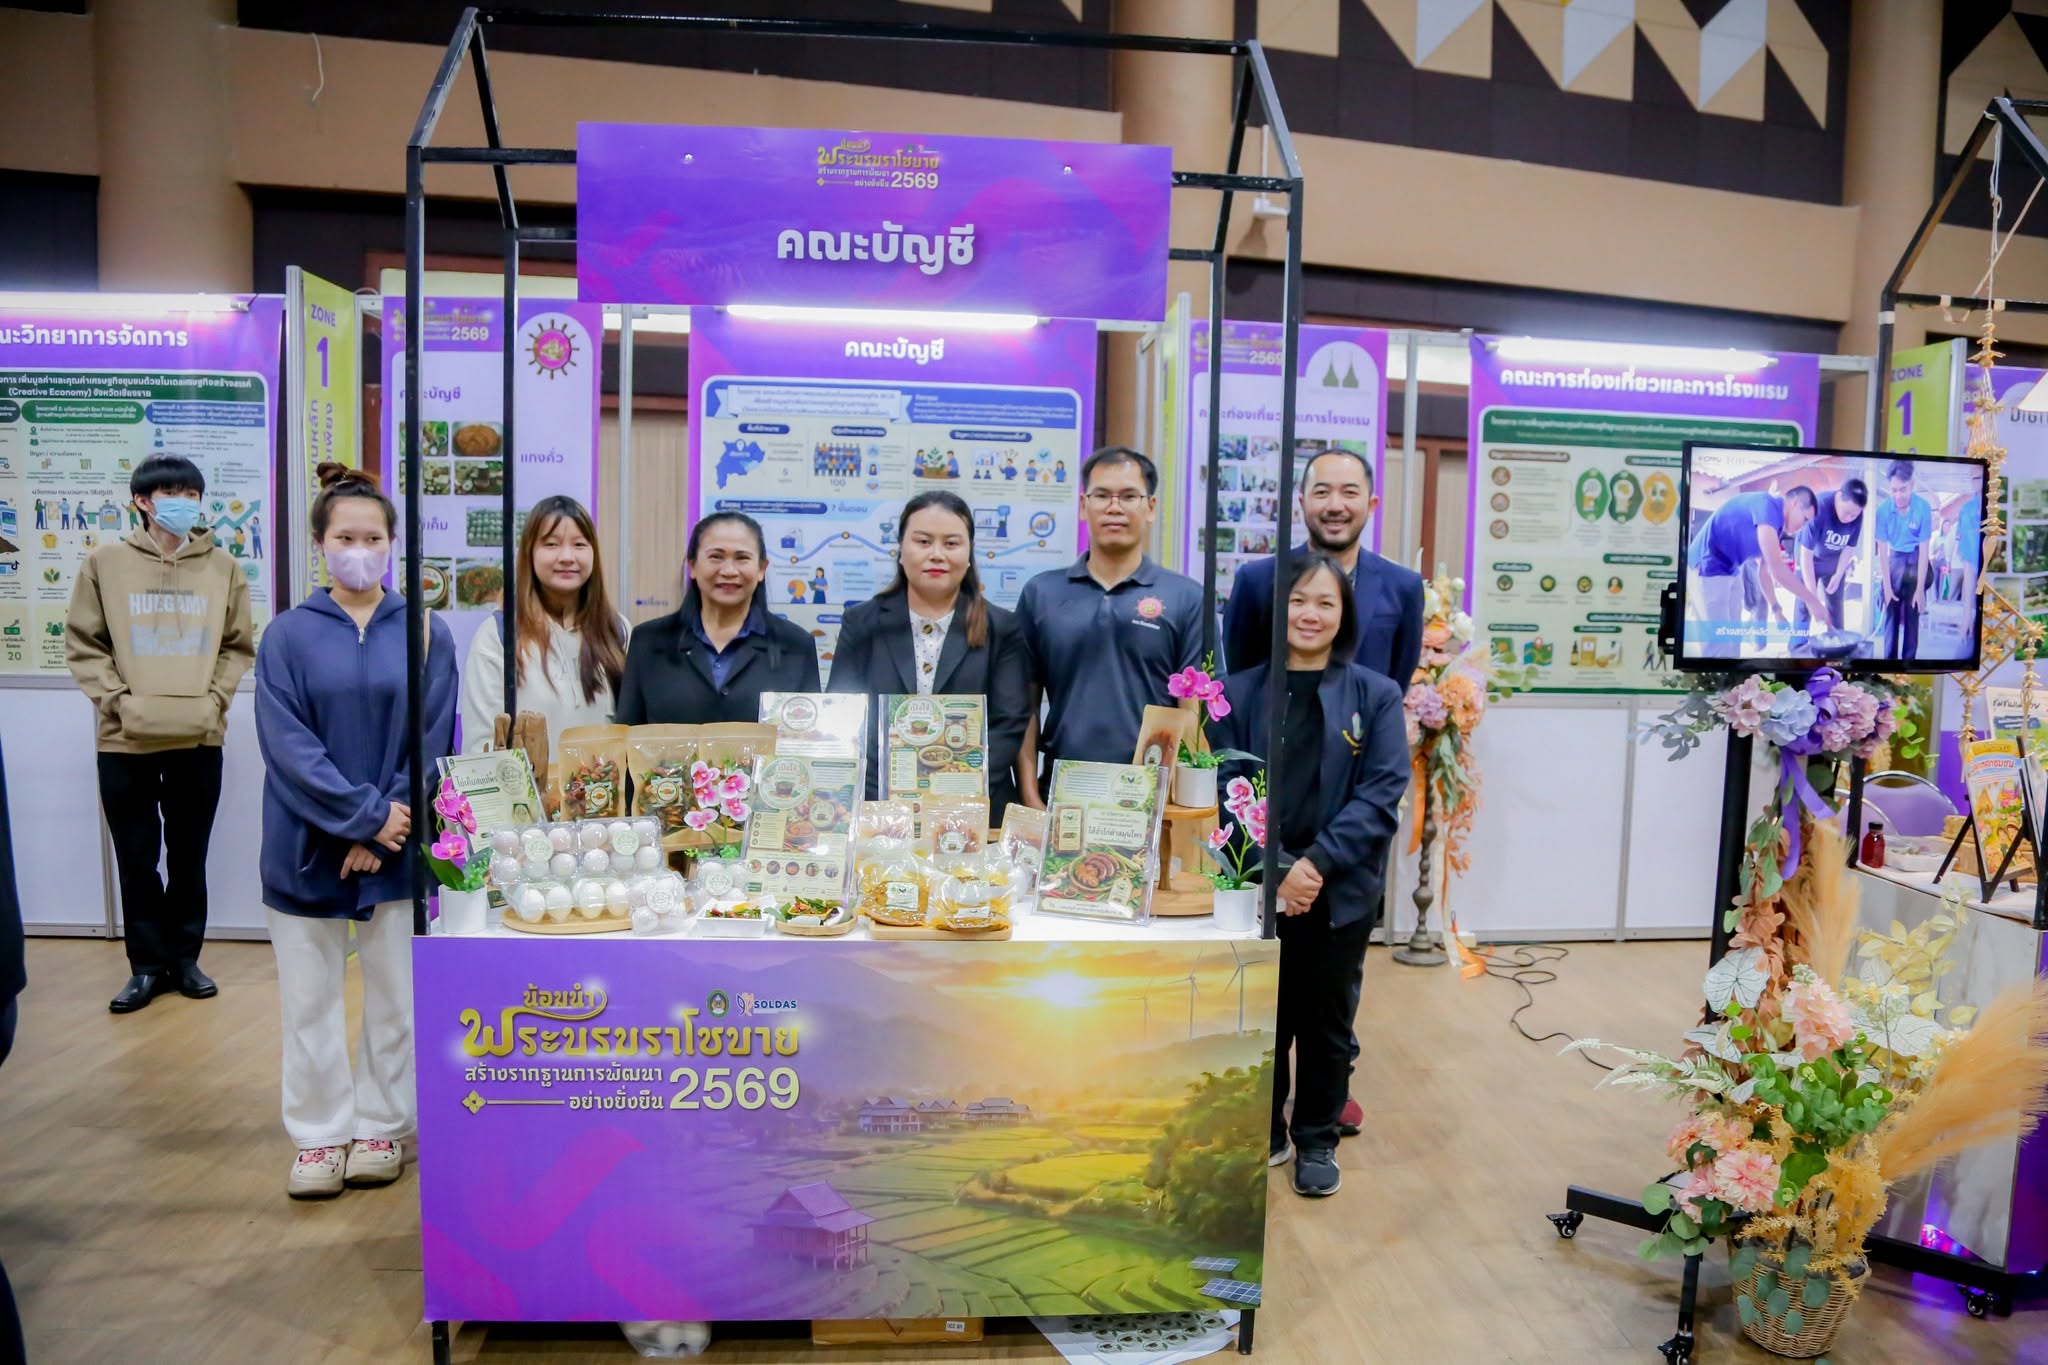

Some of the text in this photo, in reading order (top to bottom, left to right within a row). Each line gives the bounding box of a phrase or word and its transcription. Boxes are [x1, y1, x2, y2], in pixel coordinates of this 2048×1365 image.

[817, 146, 940, 170] พระบรมราโชบาย
[890, 171, 939, 189] 2569
[776, 220, 976, 276] คณะบัญชี
[311, 303, 336, 327] ZONE
[451, 326, 489, 341] 2569
[316, 336, 329, 388] 1
[844, 337, 945, 365] คณะบัญชี
[8, 387, 48, 398] (Creative
[49, 387, 92, 398] Economy)
[1501, 365, 1789, 400] คณะการท่องเที่ยวและการโรงแรม
[1896, 390, 1912, 436] 1
[830, 479, 846, 487] 100
[7, 651, 22, 661] 20
[523, 982, 595, 1008] น้อมนำ
[753, 999, 798, 1010] SOLDAS
[459, 1007, 801, 1057] พระบรมราโชบาย
[465, 1062, 663, 1089] สร้างรากฐานการพัฒนา
[669, 1066, 800, 1110] 2569
[569, 1084, 664, 1111] อย่างยั่งยืน
